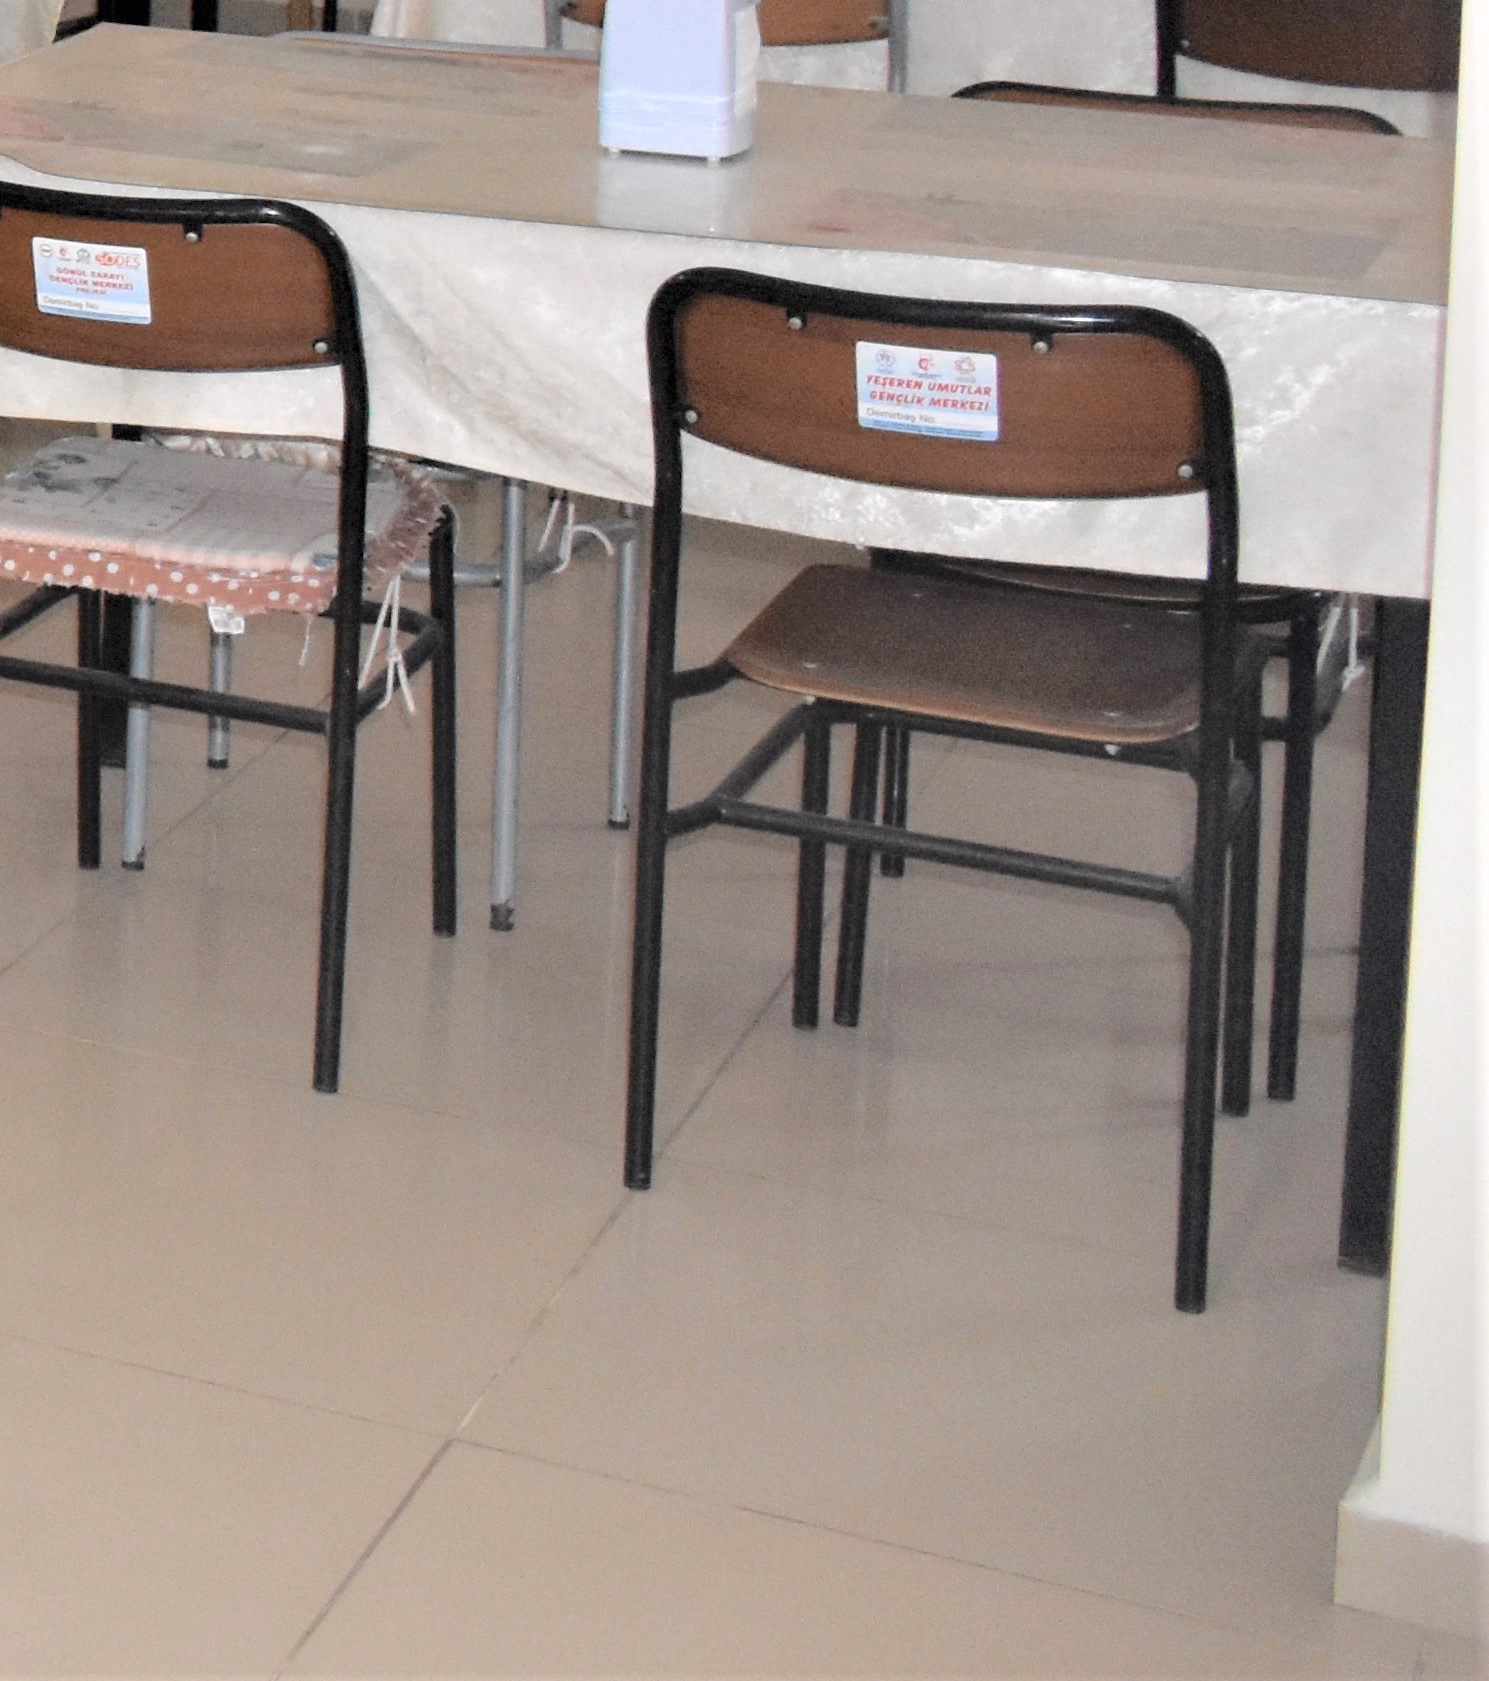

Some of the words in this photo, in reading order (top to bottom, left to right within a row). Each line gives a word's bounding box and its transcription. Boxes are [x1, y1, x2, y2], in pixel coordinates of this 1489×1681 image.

[865, 374, 923, 391] YEŞEREN
[927, 381, 993, 397] UMUTLAR
[869, 390, 925, 407] GENÇLİK
[929, 397, 990, 411] MERKEZİ
